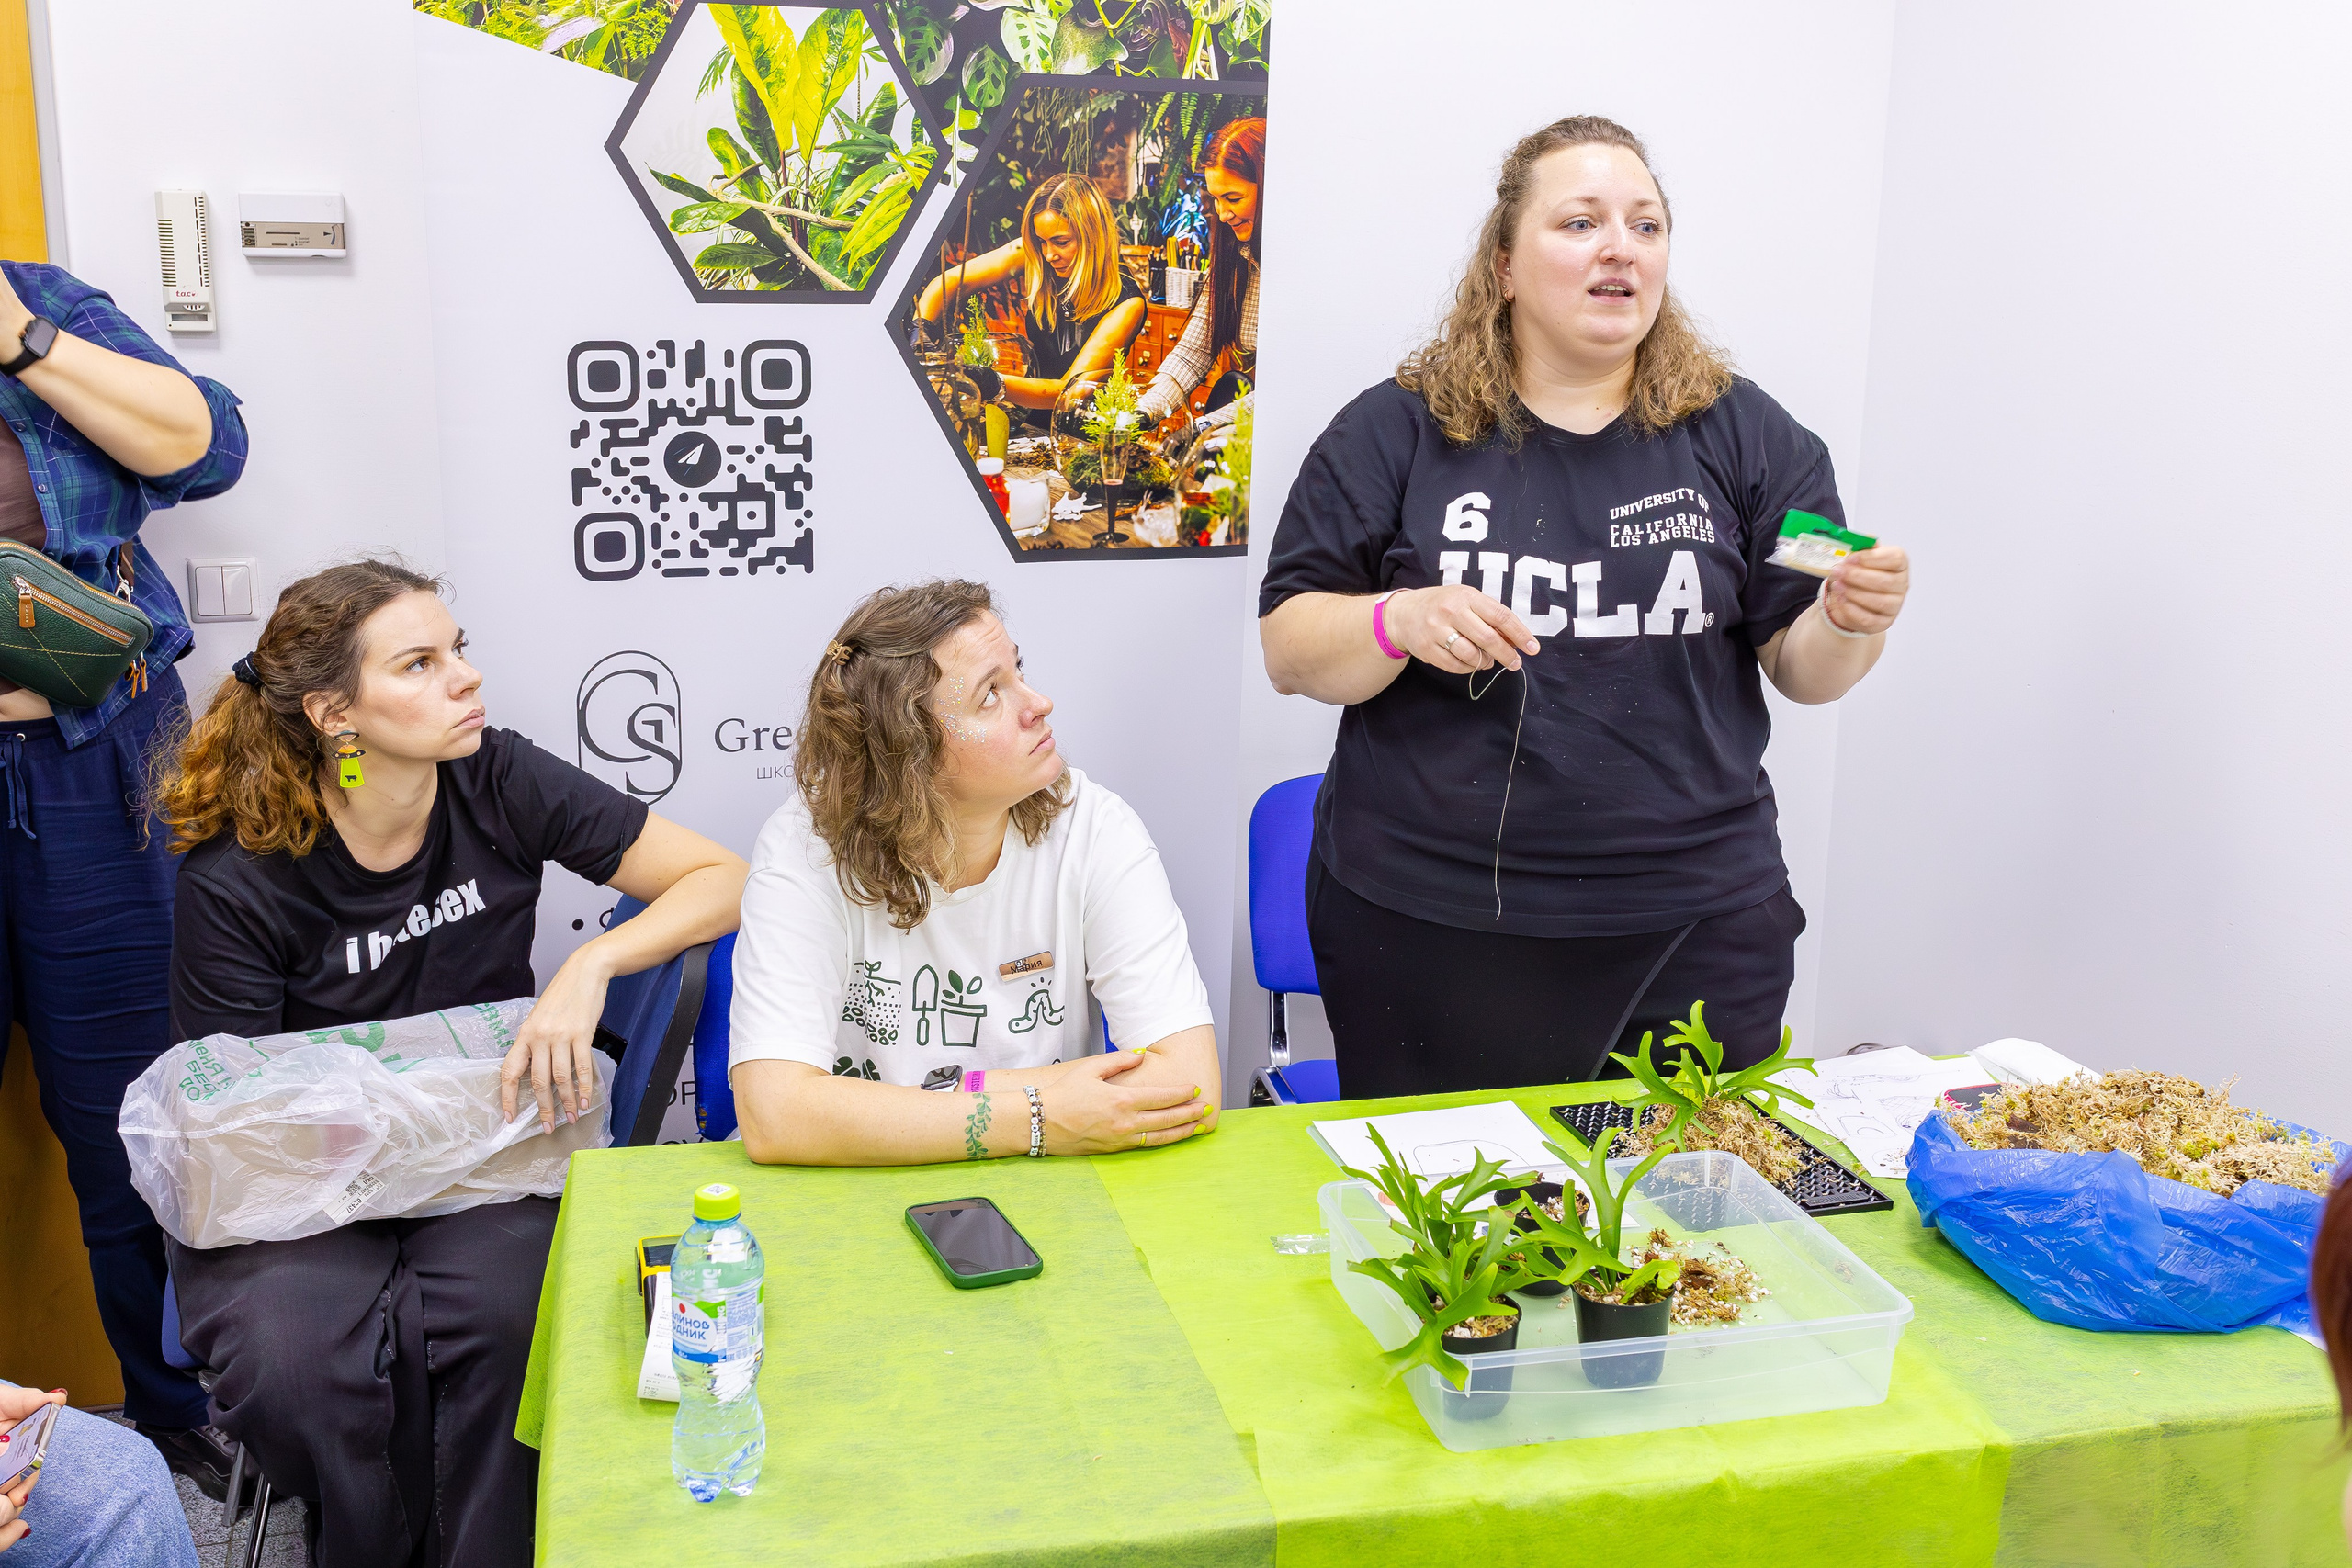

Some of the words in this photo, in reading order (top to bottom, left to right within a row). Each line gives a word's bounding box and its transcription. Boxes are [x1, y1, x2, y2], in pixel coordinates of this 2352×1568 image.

[1442, 491, 1491, 543] 6
[1610, 487, 1695, 520] UNIVERSITY
[1697, 493, 1710, 513] OF
[1610, 513, 1714, 536] CALIFORNIA
[1610, 535, 1641, 548] LOS
[1648, 525, 1715, 544] ANGELES
[1439, 550, 1706, 637] UCLA
[715, 718, 793, 753] Gre
[756, 764, 795, 779] ШКО
[346, 936, 361, 974] i
[346, 1198, 363, 1213] 02437
[672, 1320, 707, 1340] ОДНИК
